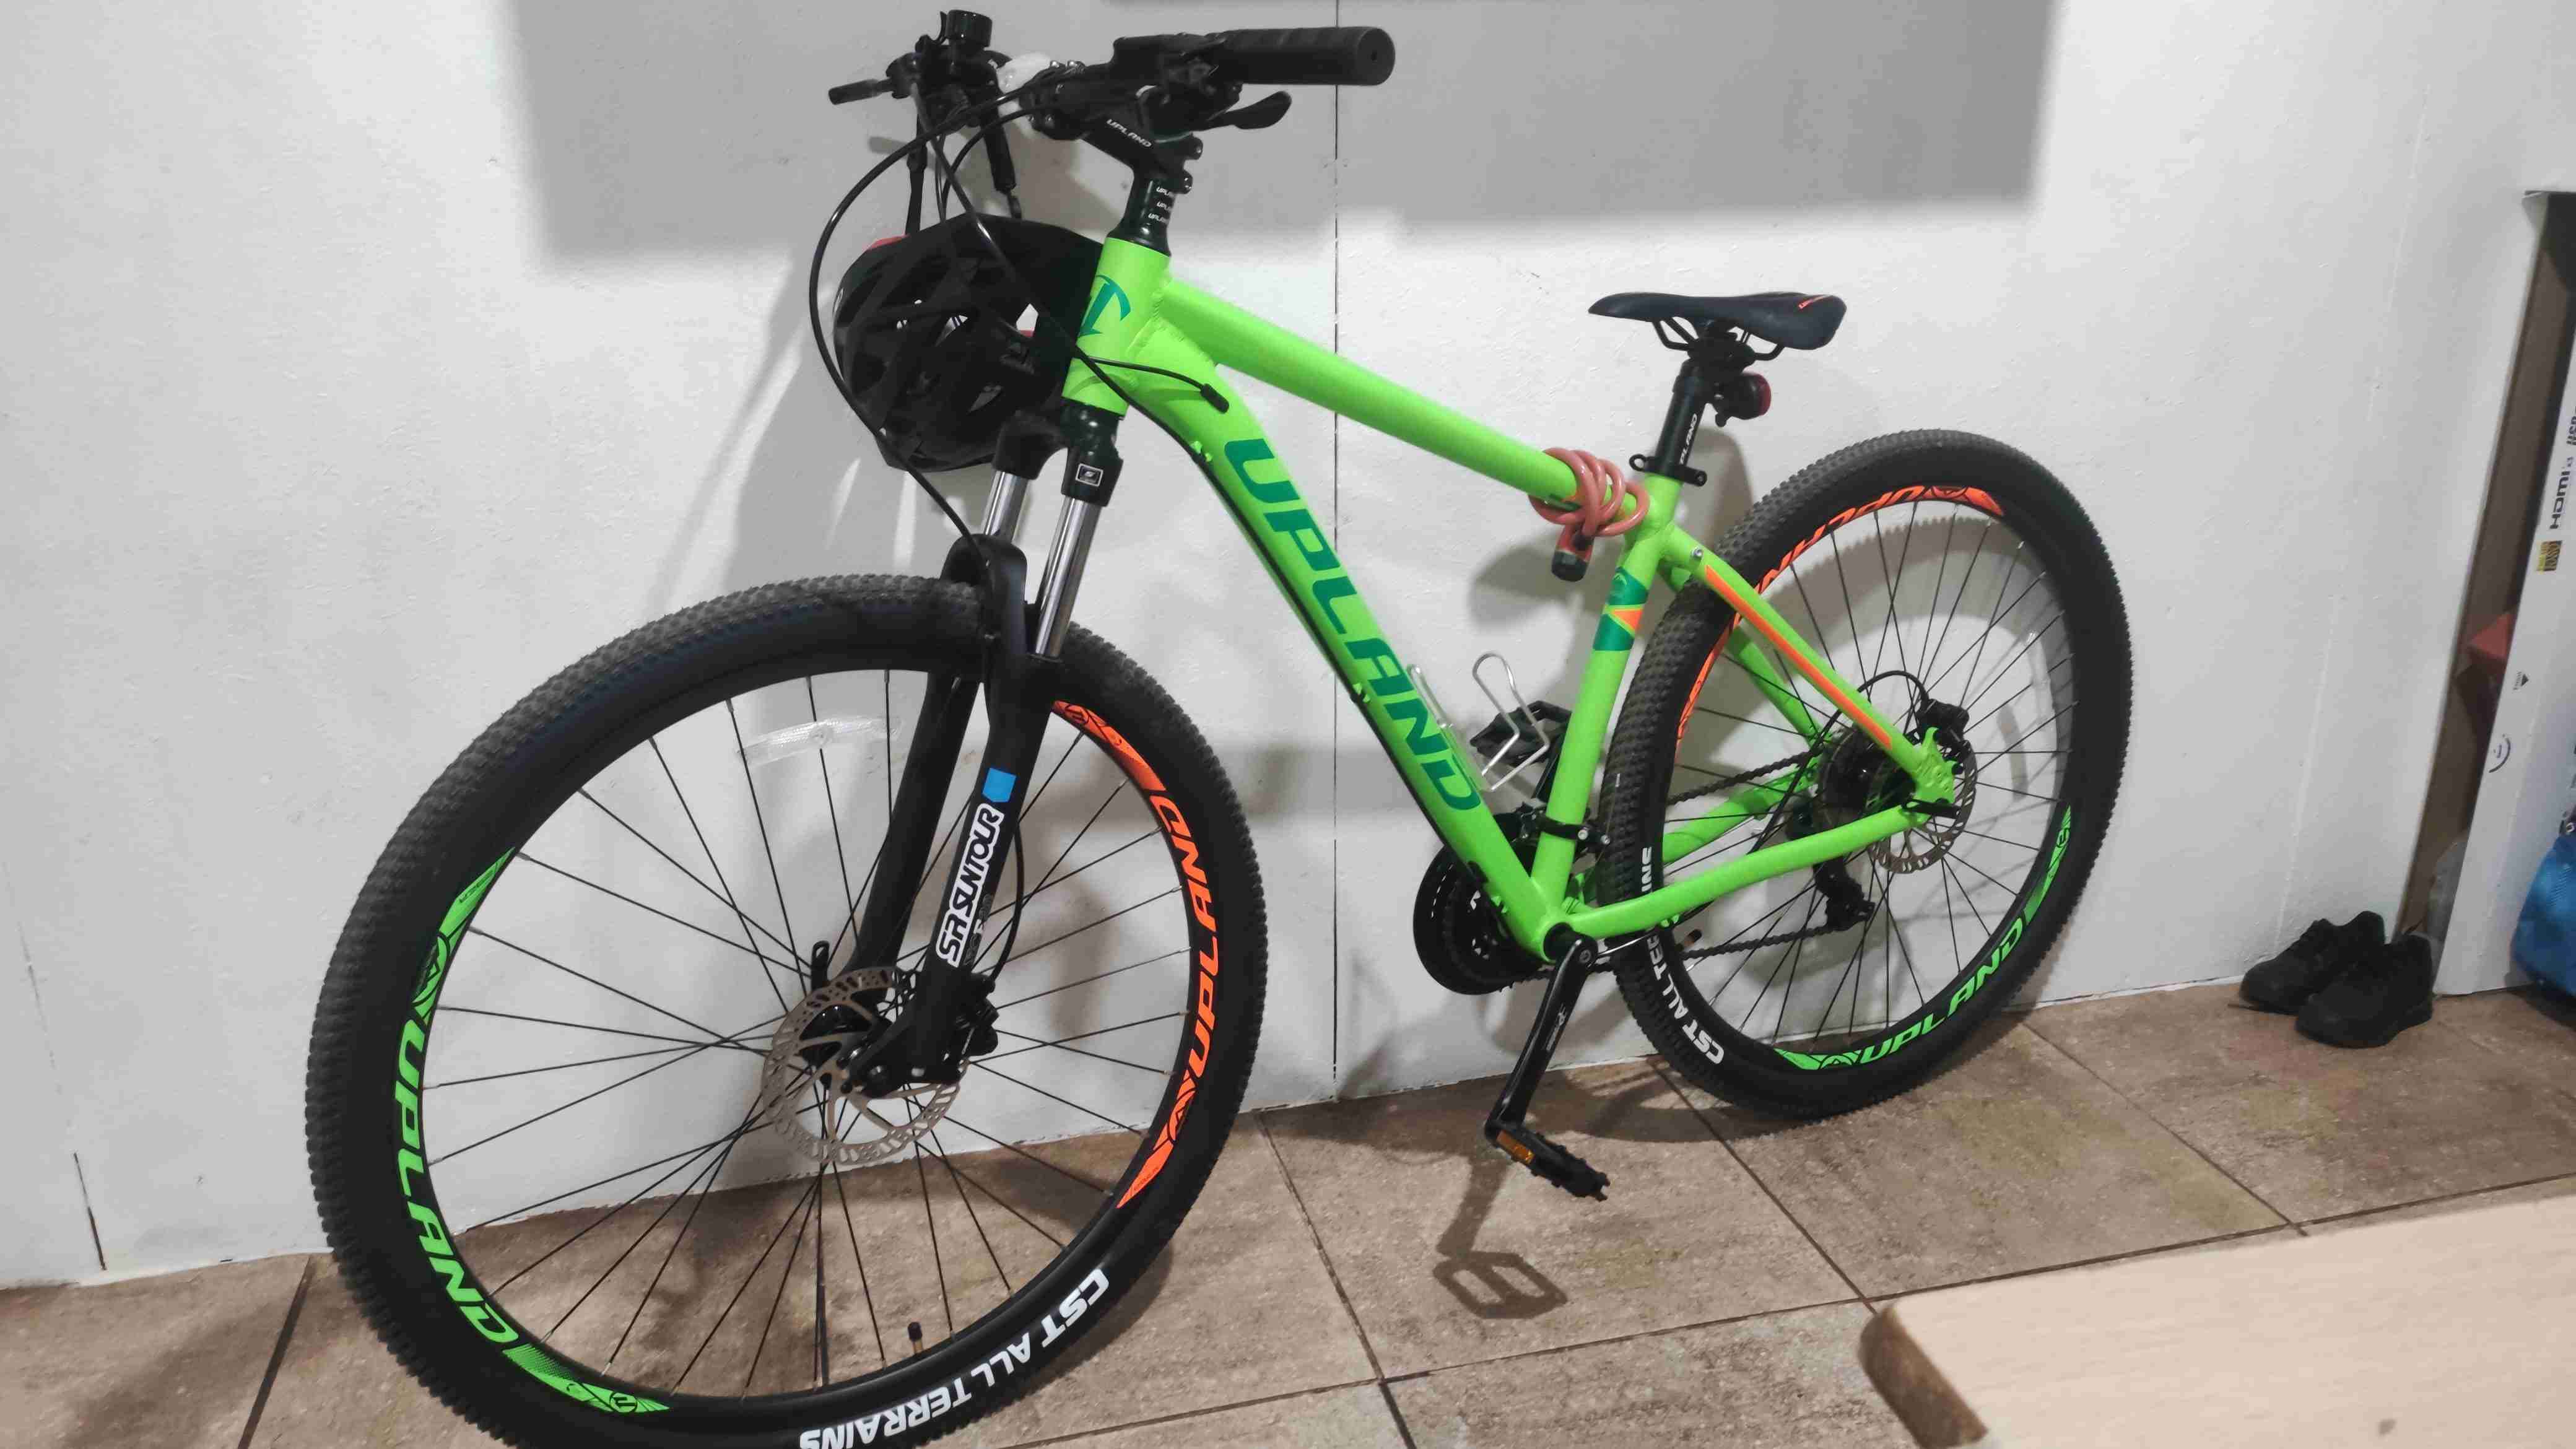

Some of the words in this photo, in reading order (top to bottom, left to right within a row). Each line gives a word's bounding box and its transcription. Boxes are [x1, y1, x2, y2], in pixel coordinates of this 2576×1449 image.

[1107, 119, 1152, 147] UPLAND
[1679, 413, 1697, 465] PLAND
[2550, 471, 2570, 529] HDMI
[1224, 438, 1481, 810] UPLAND
[951, 805, 1001, 919] SUNTOUR
[1150, 794, 1219, 1078] UPLAND
[1663, 973, 1689, 1019] ALL
[1860, 917, 2023, 1064] UPLAND
[1682, 1019, 1725, 1064] CST
[395, 1019, 518, 1343] UPLAND
[1040, 1268, 1110, 1348] CST
[970, 1332, 1031, 1387] ALL
[799, 1377, 972, 1449] TERRAINS
